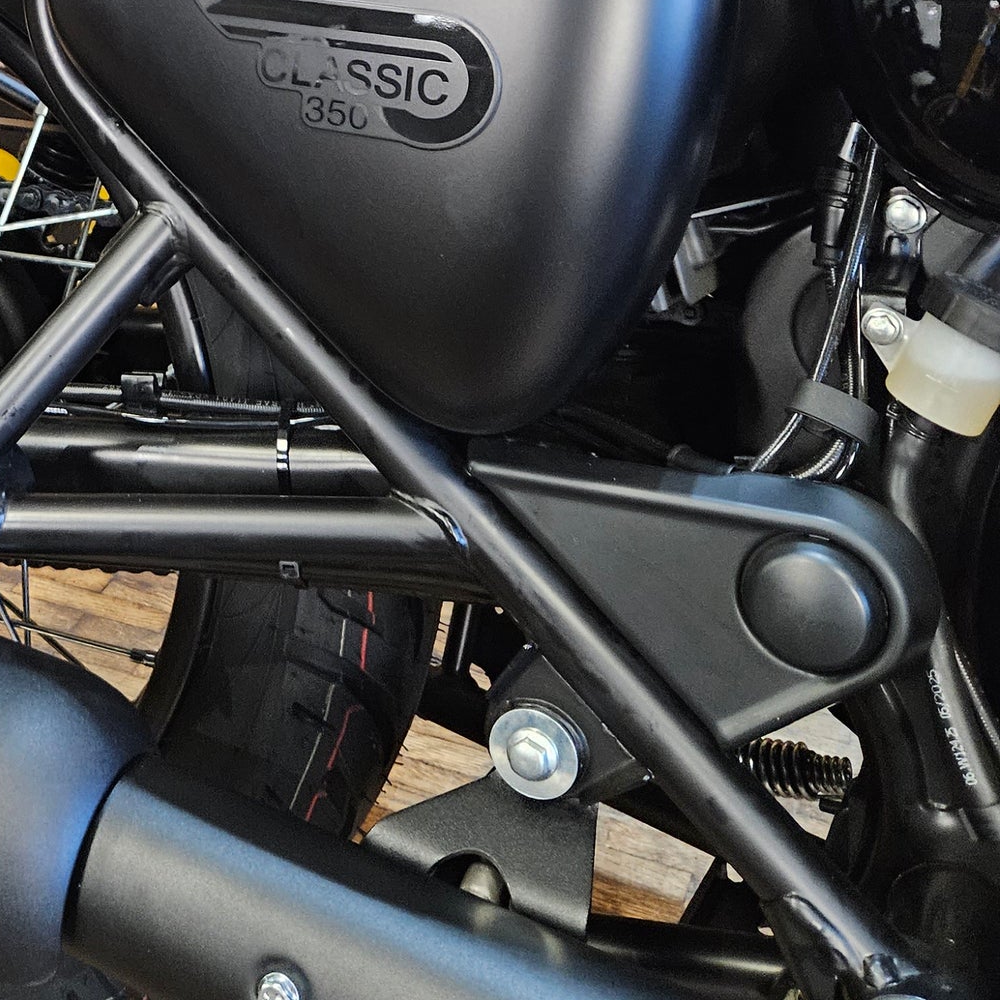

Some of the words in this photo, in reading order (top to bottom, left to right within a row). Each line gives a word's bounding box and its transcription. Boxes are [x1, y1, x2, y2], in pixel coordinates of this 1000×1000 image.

[261, 48, 449, 106] CLASSIC
[305, 96, 369, 131] 350
[927, 669, 952, 719] 05/2025
